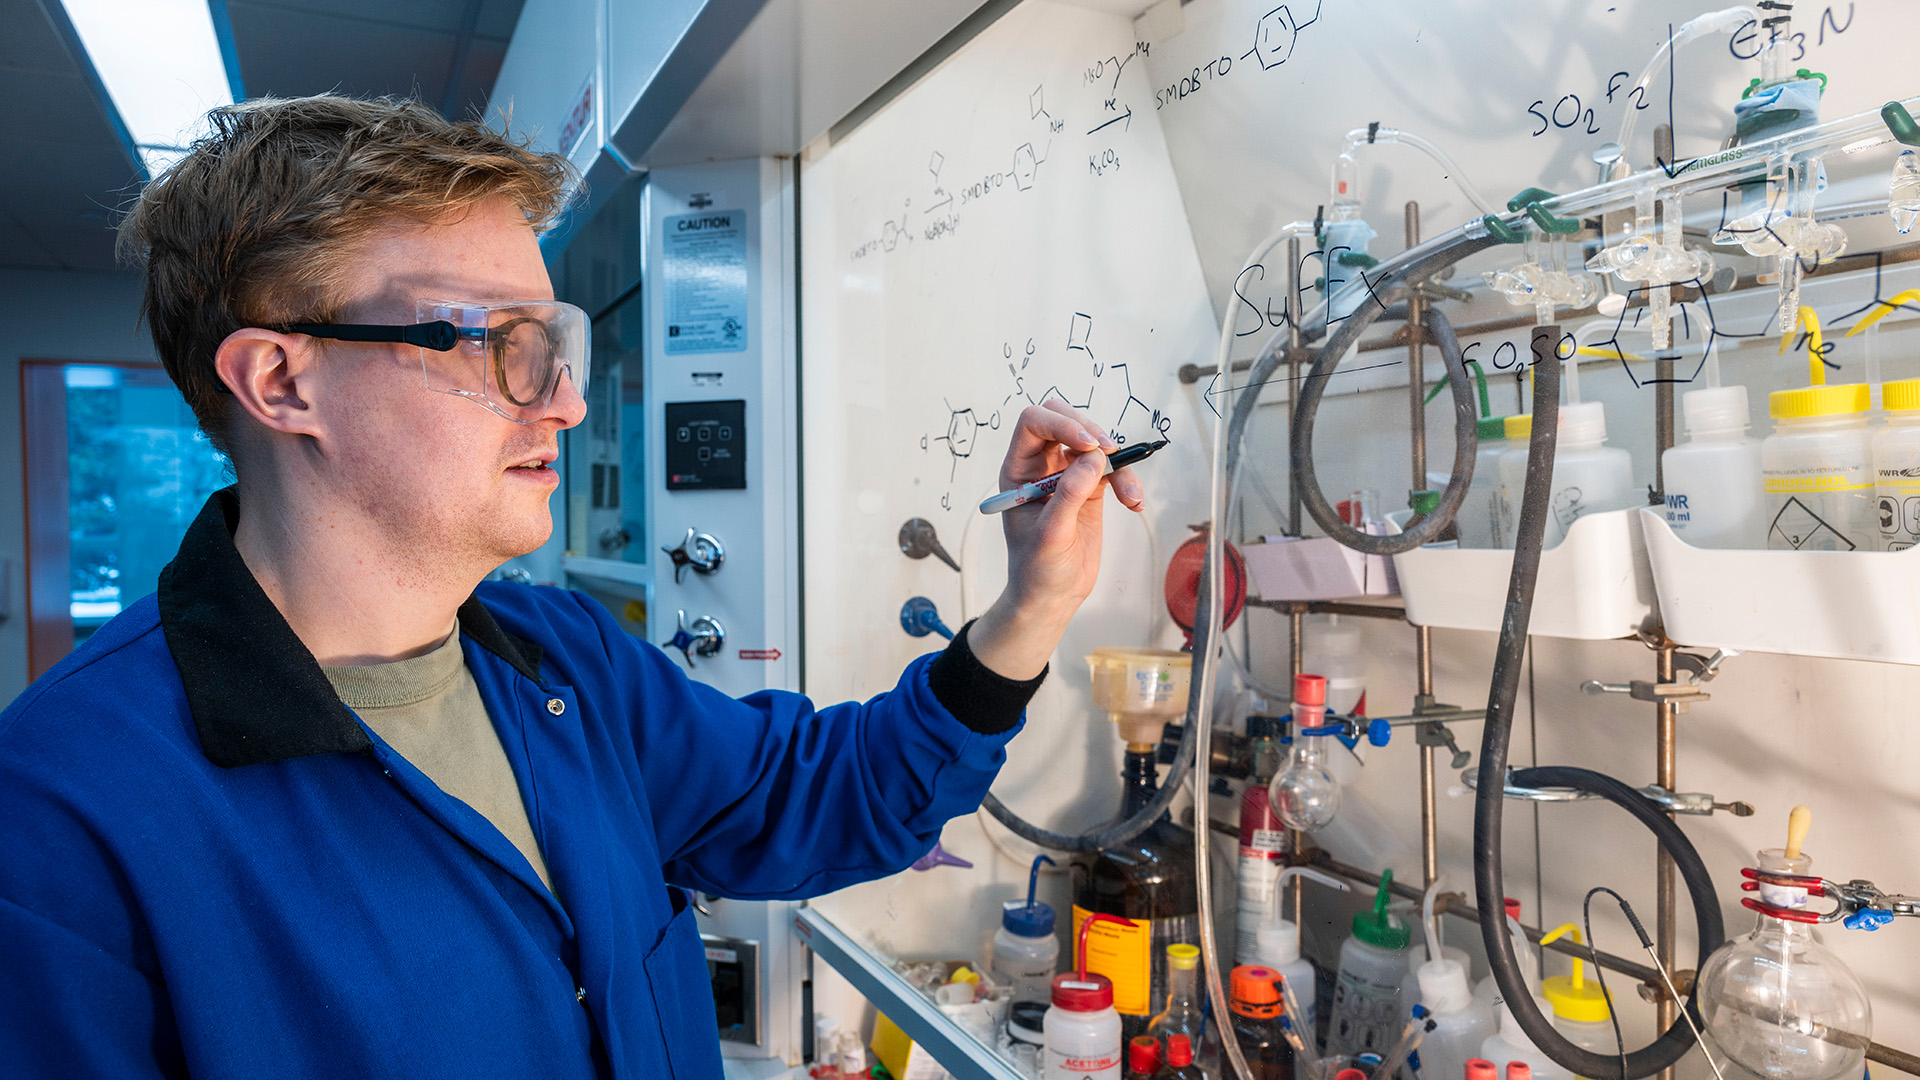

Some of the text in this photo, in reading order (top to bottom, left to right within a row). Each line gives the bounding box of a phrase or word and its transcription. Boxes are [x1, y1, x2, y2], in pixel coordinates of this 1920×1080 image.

[1156, 56, 1232, 110] SMDBTO
[1527, 72, 1650, 137] SO2F2
[1050, 119, 1064, 133] NH
[1089, 148, 1120, 177] K2CO3
[961, 172, 1003, 206] SMDBTO
[677, 217, 731, 232] CAUTION
[1093, 362, 1104, 378] N
[1016, 376, 1024, 396] S
[990, 409, 1001, 430] O
[1878, 469, 1899, 477] VWR
[1677, 511, 1690, 521] ml
[1792, 535, 1800, 544] 3
